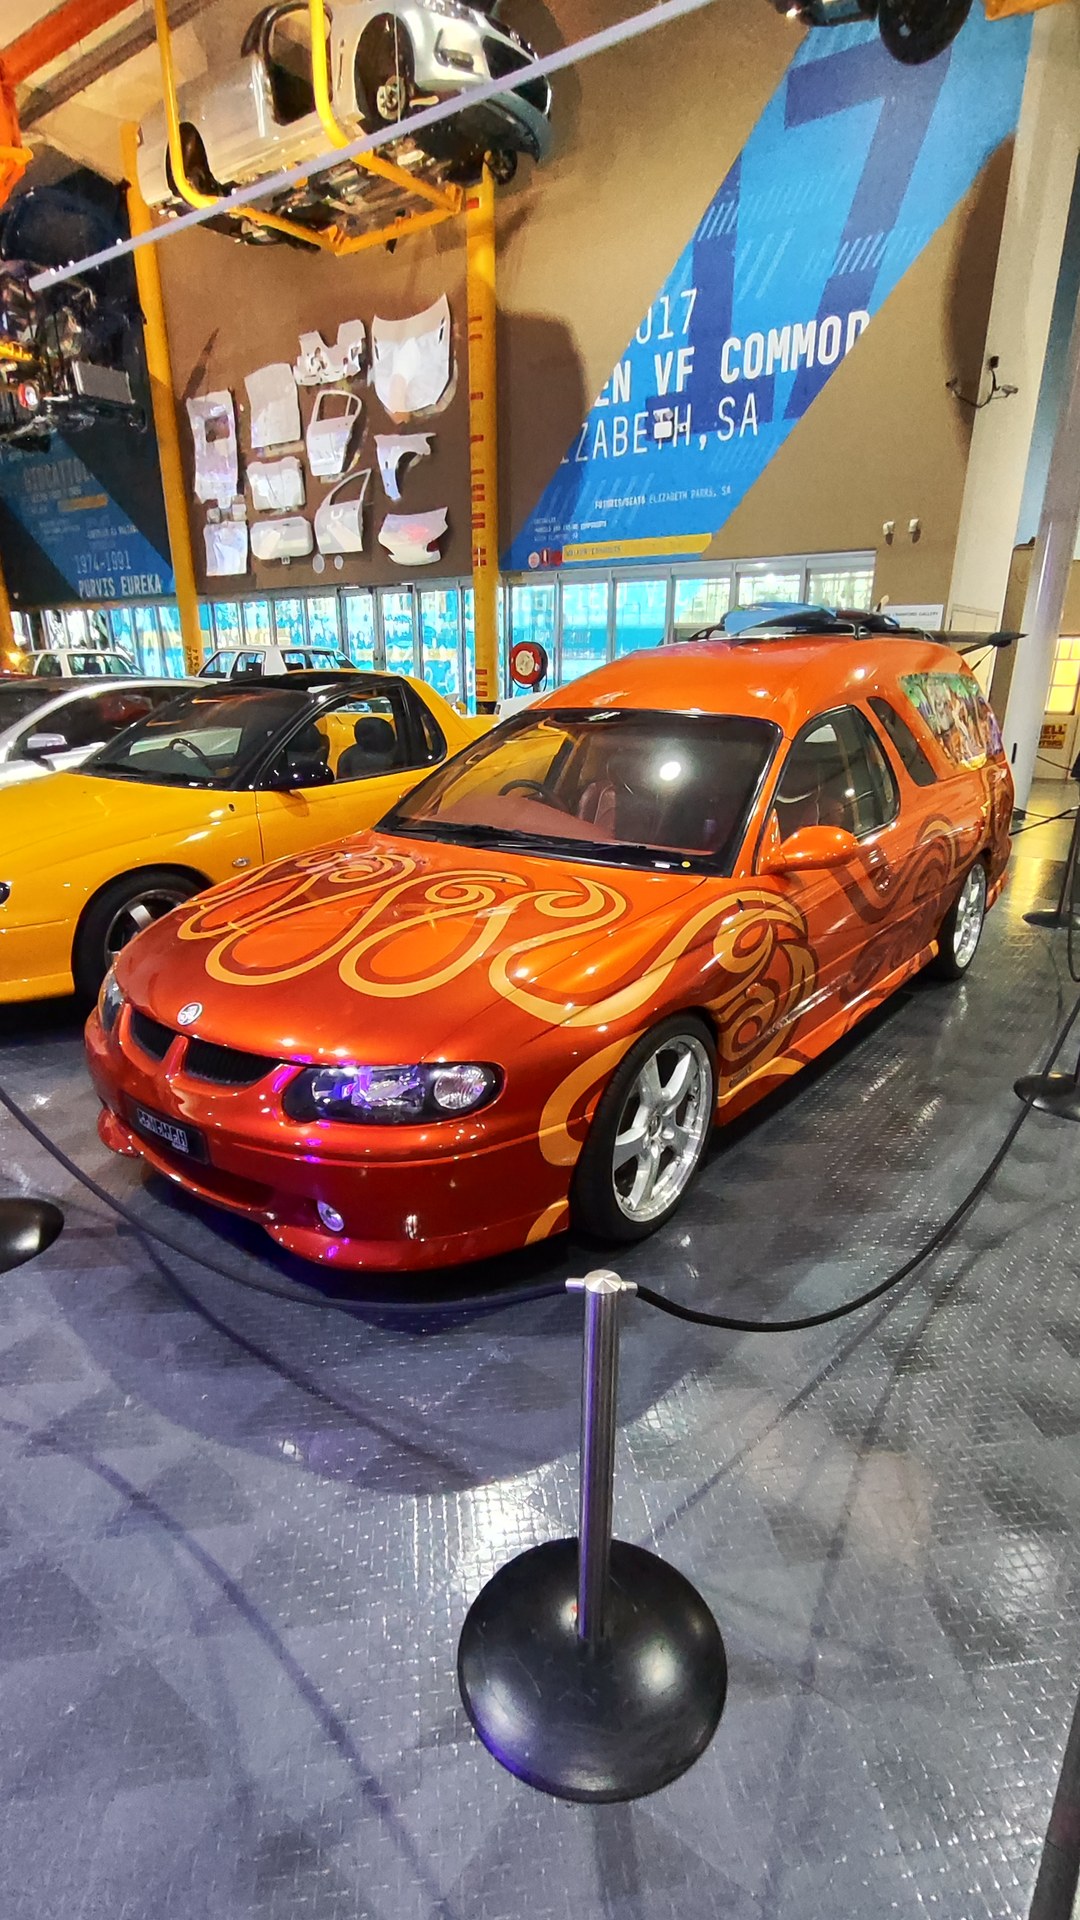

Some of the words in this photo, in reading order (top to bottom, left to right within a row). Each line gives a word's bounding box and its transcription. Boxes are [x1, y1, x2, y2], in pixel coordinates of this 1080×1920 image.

[628, 287, 698, 346] 017
[654, 345, 695, 397] VF
[78, 576, 116, 600] PURVIS
[120, 573, 162, 596] EUREKA
